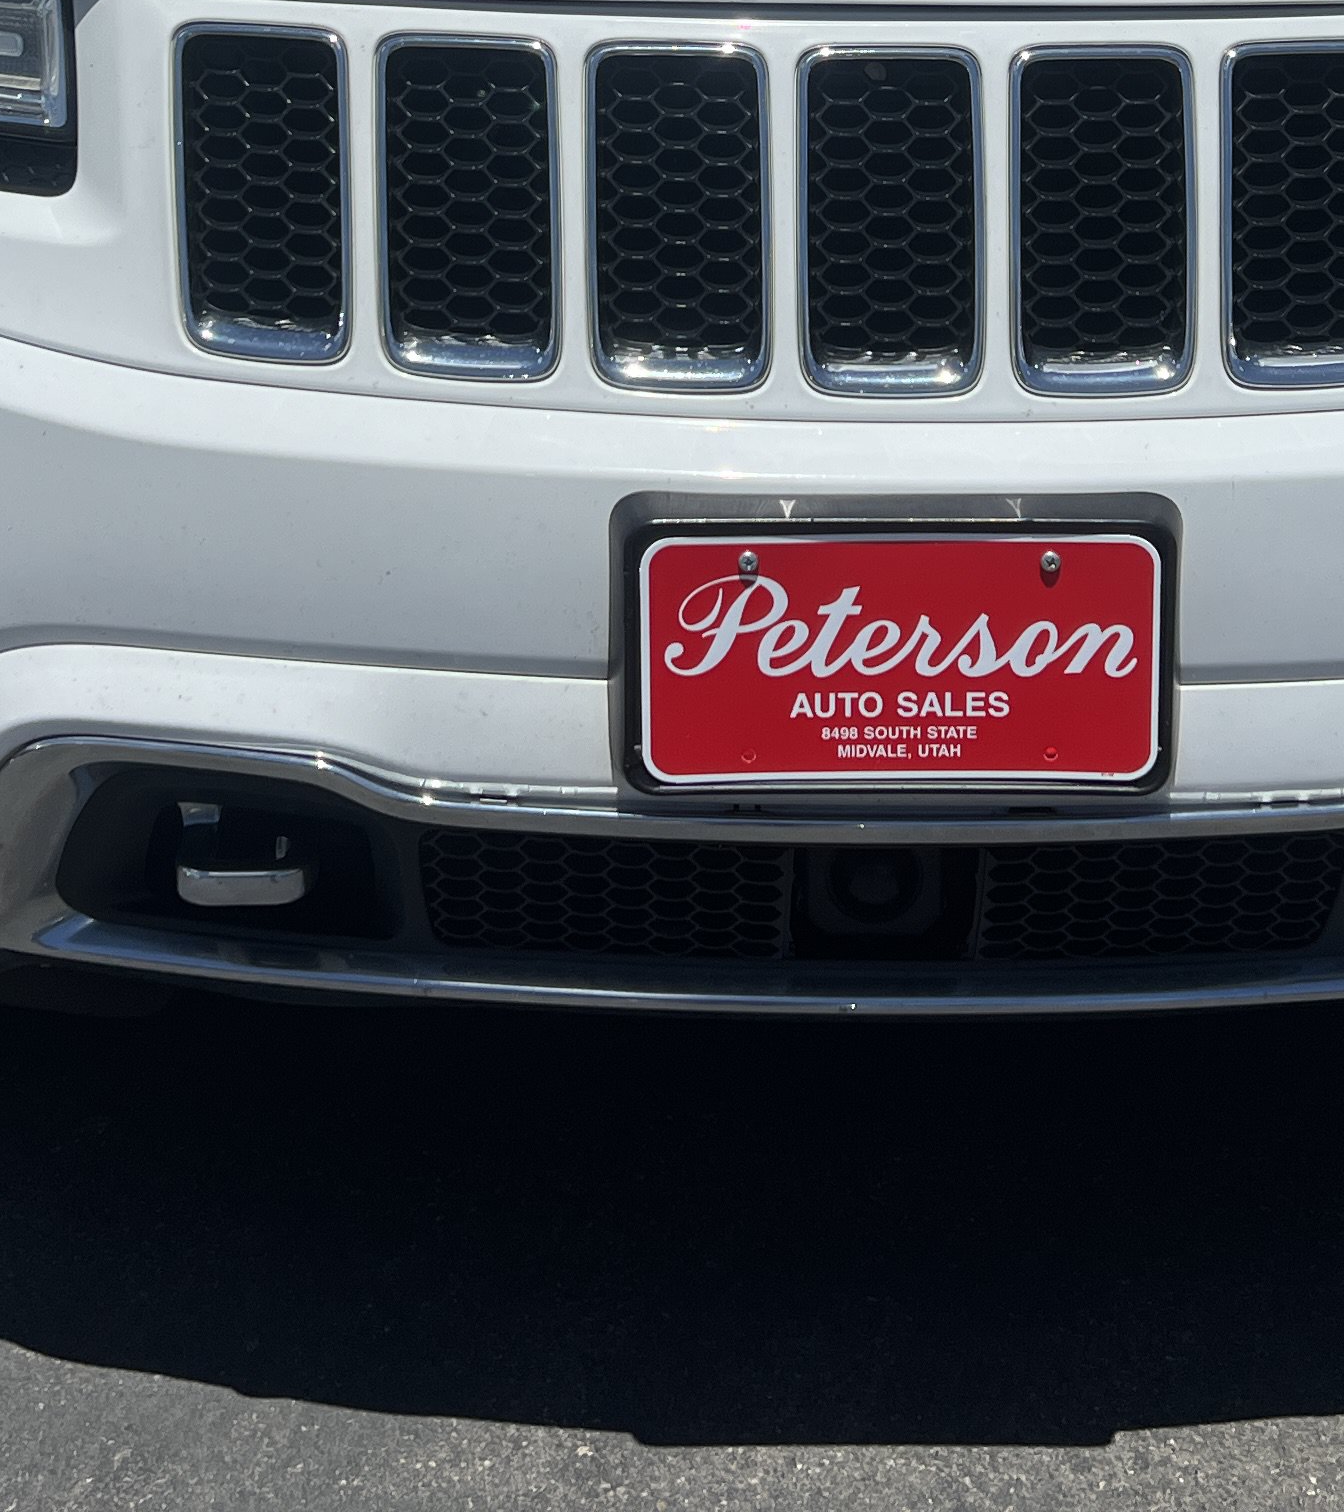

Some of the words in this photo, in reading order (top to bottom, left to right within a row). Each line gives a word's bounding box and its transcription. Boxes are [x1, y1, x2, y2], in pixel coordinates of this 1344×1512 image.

[663, 573, 1139, 679] Peterson
[789, 691, 884, 719] AUTO
[896, 691, 1010, 719] SALES
[820, 726, 858, 741] 8498
[863, 726, 921, 740] SOUTH
[927, 726, 978, 740] STATE
[837, 743, 912, 760] MIDVALE,
[918, 743, 962, 758] UTAH
